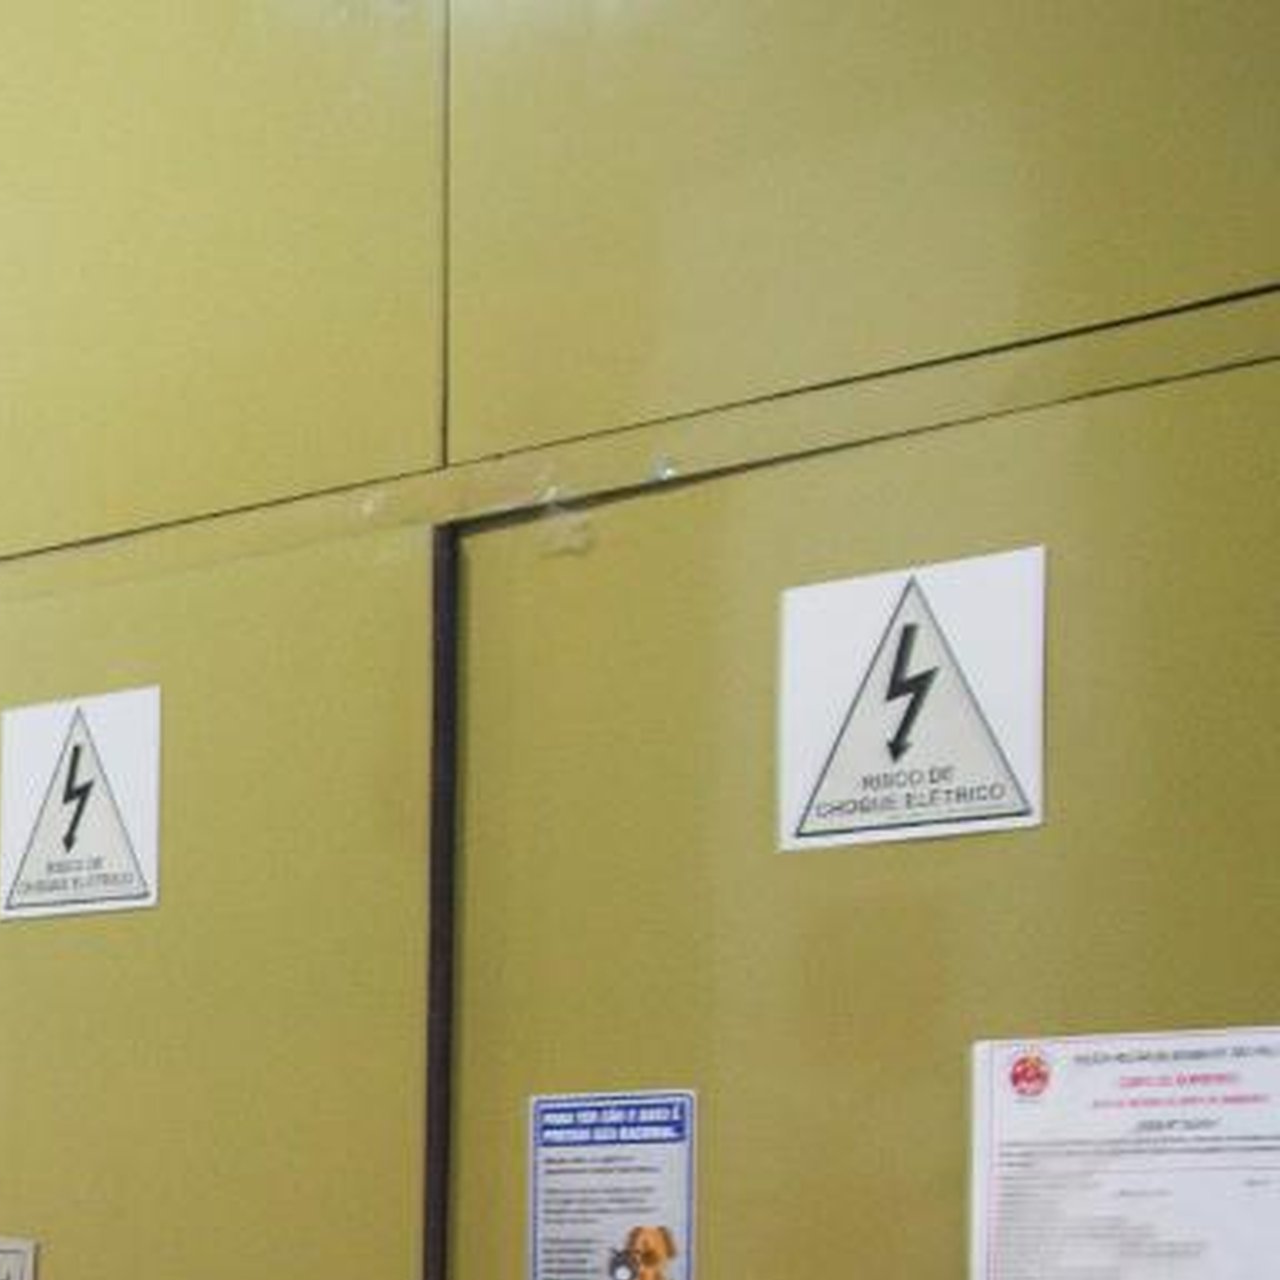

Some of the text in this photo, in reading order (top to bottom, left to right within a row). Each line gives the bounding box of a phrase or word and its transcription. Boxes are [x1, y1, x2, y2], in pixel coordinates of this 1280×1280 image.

[862, 767, 955, 791] RISCO DE
[816, 796, 897, 818] CHOQUE
